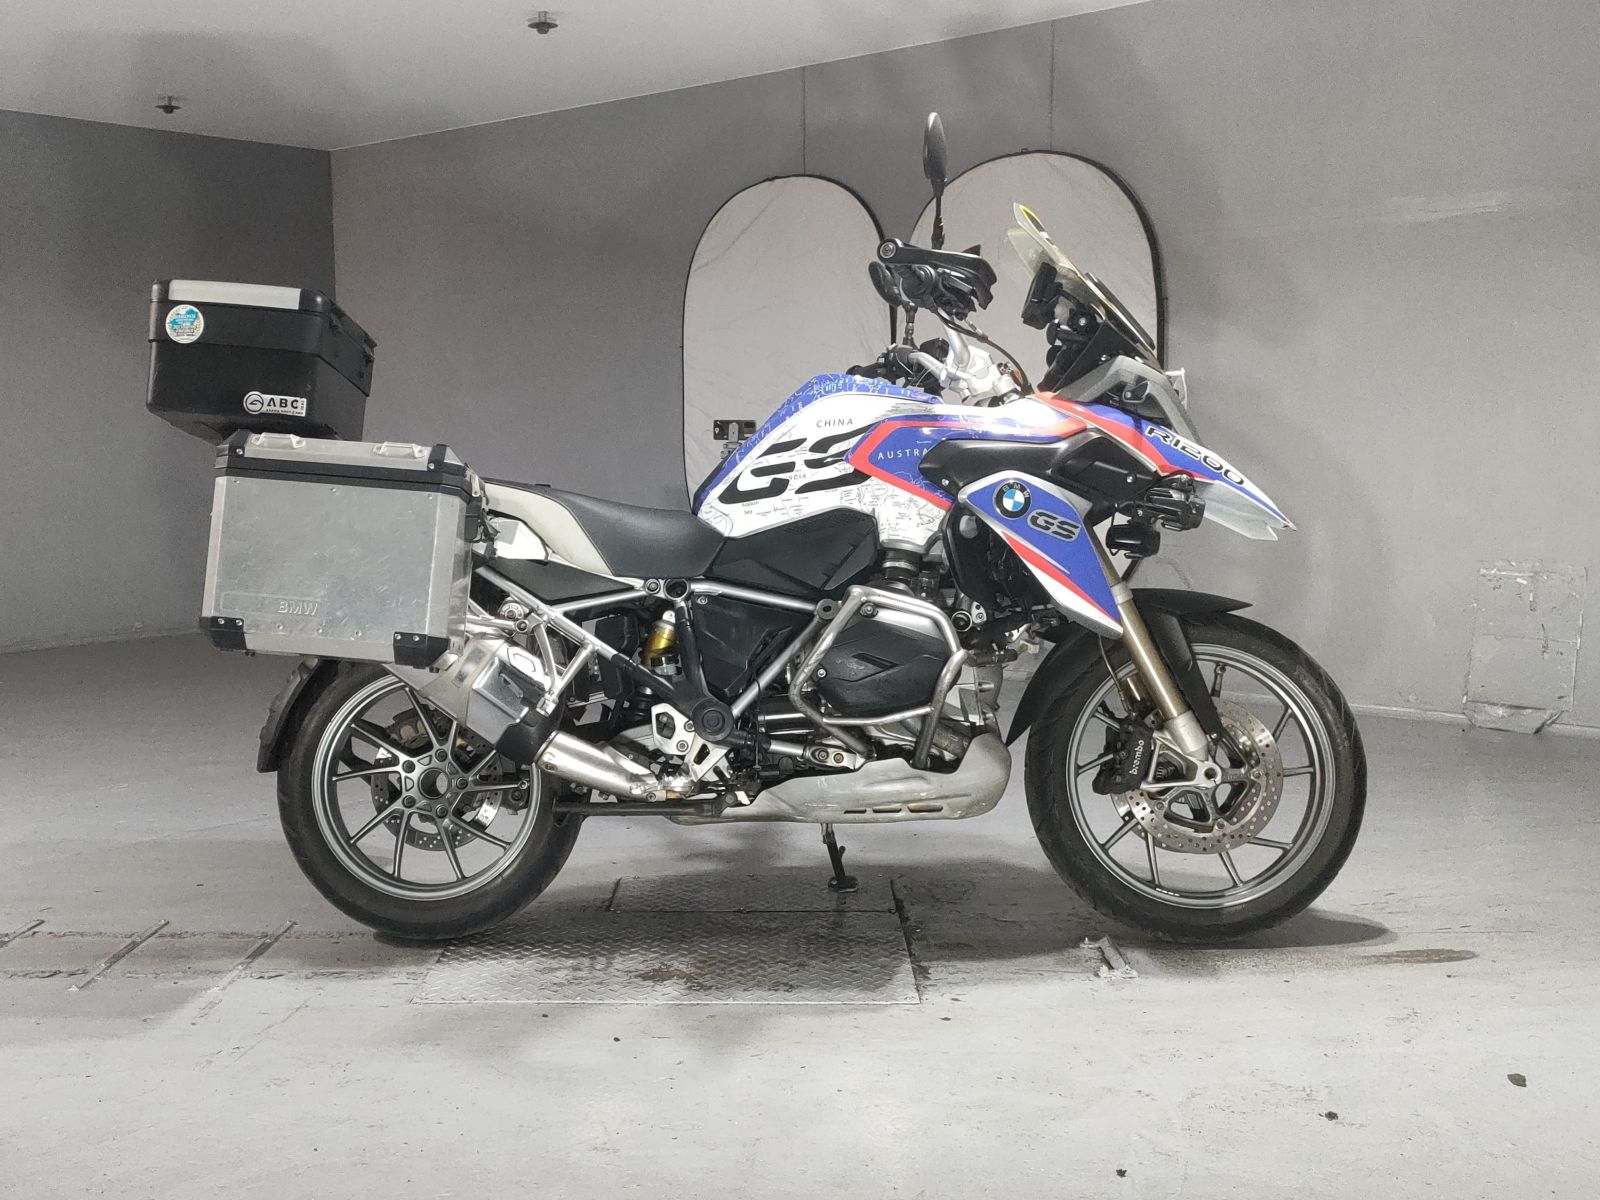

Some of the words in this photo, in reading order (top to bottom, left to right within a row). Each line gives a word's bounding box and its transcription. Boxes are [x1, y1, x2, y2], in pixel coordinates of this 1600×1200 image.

[267, 397, 299, 409] ABC
[816, 419, 853, 427] CHINA
[1146, 426, 1244, 486] R1200
[1002, 483, 1030, 498] BMW
[1029, 510, 1080, 540] GS
[277, 601, 318, 616] BMW
[1129, 740, 1145, 775] brembo
